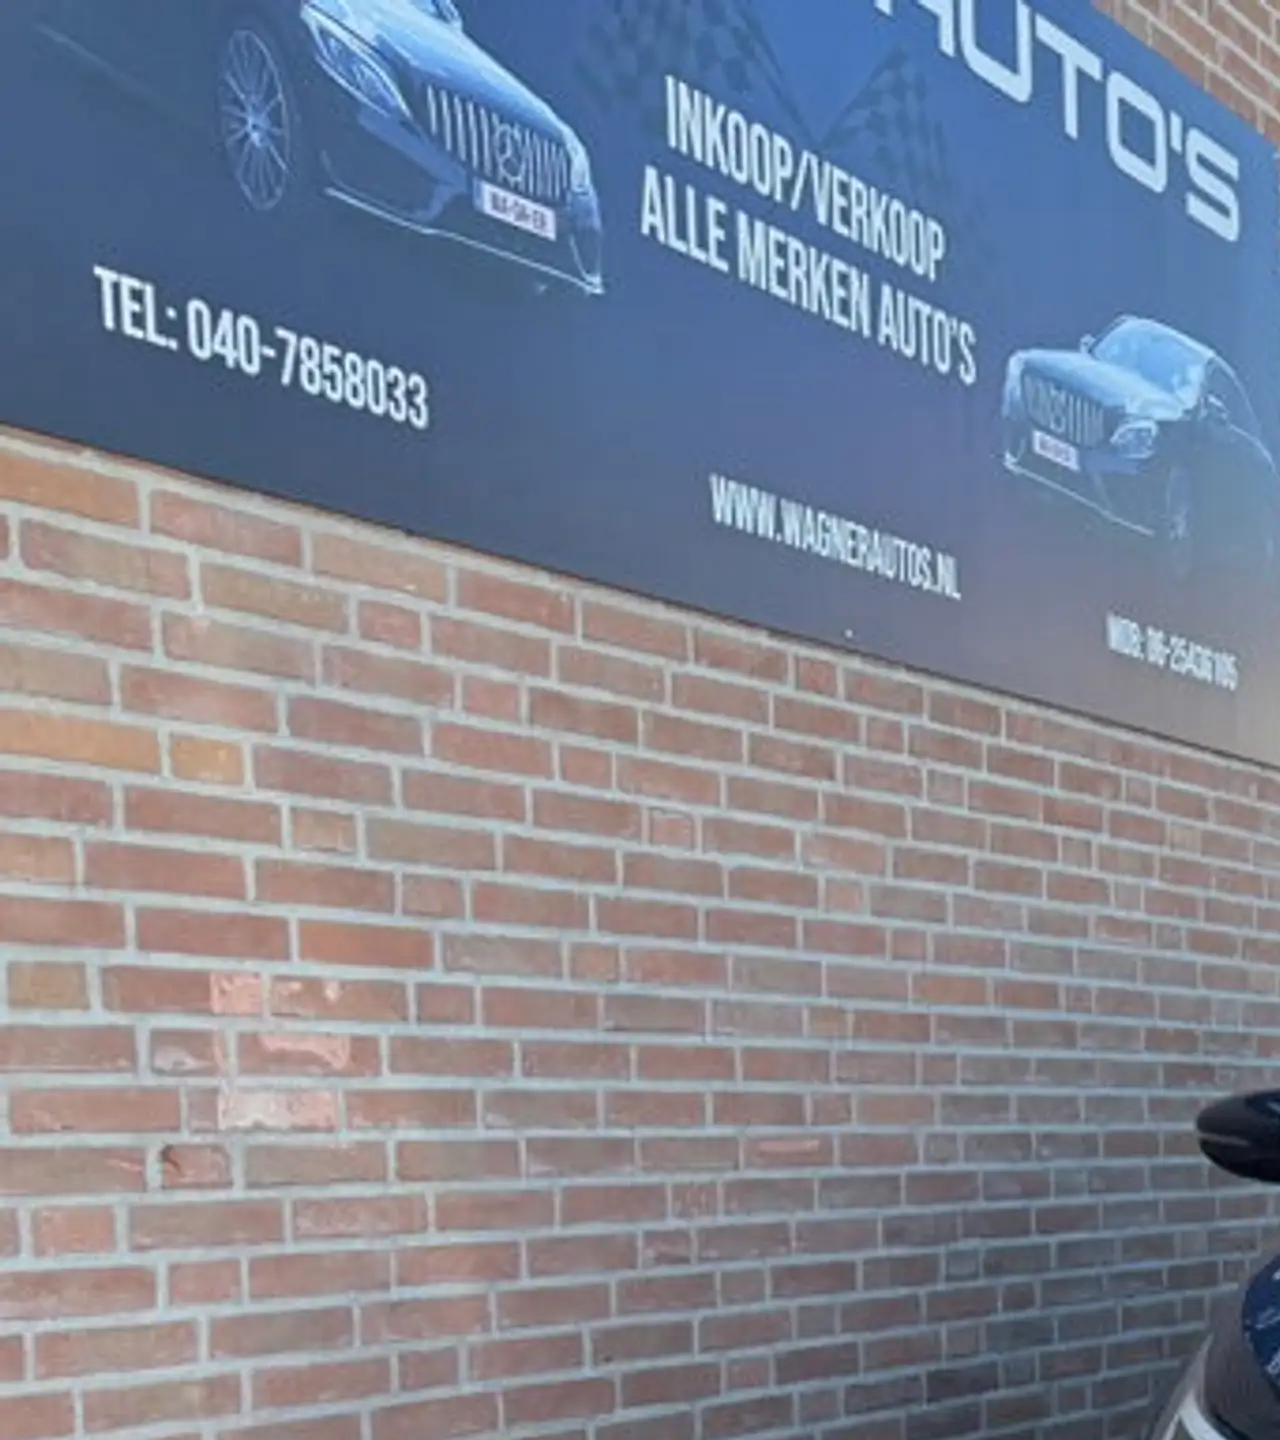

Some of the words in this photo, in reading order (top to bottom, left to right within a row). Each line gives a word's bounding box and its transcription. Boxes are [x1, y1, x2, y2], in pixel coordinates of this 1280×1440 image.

[665, 75, 946, 283] INKOOP/VERKOOP
[93, 264, 179, 351] TEL:
[186, 297, 430, 430] 040-7858033
[640, 164, 729, 273] ALLE
[737, 209, 872, 339] MERKEN
[877, 281, 978, 387] AUTO'S
[708, 472, 963, 601] WWW.WAGNERAUTOS.NL
